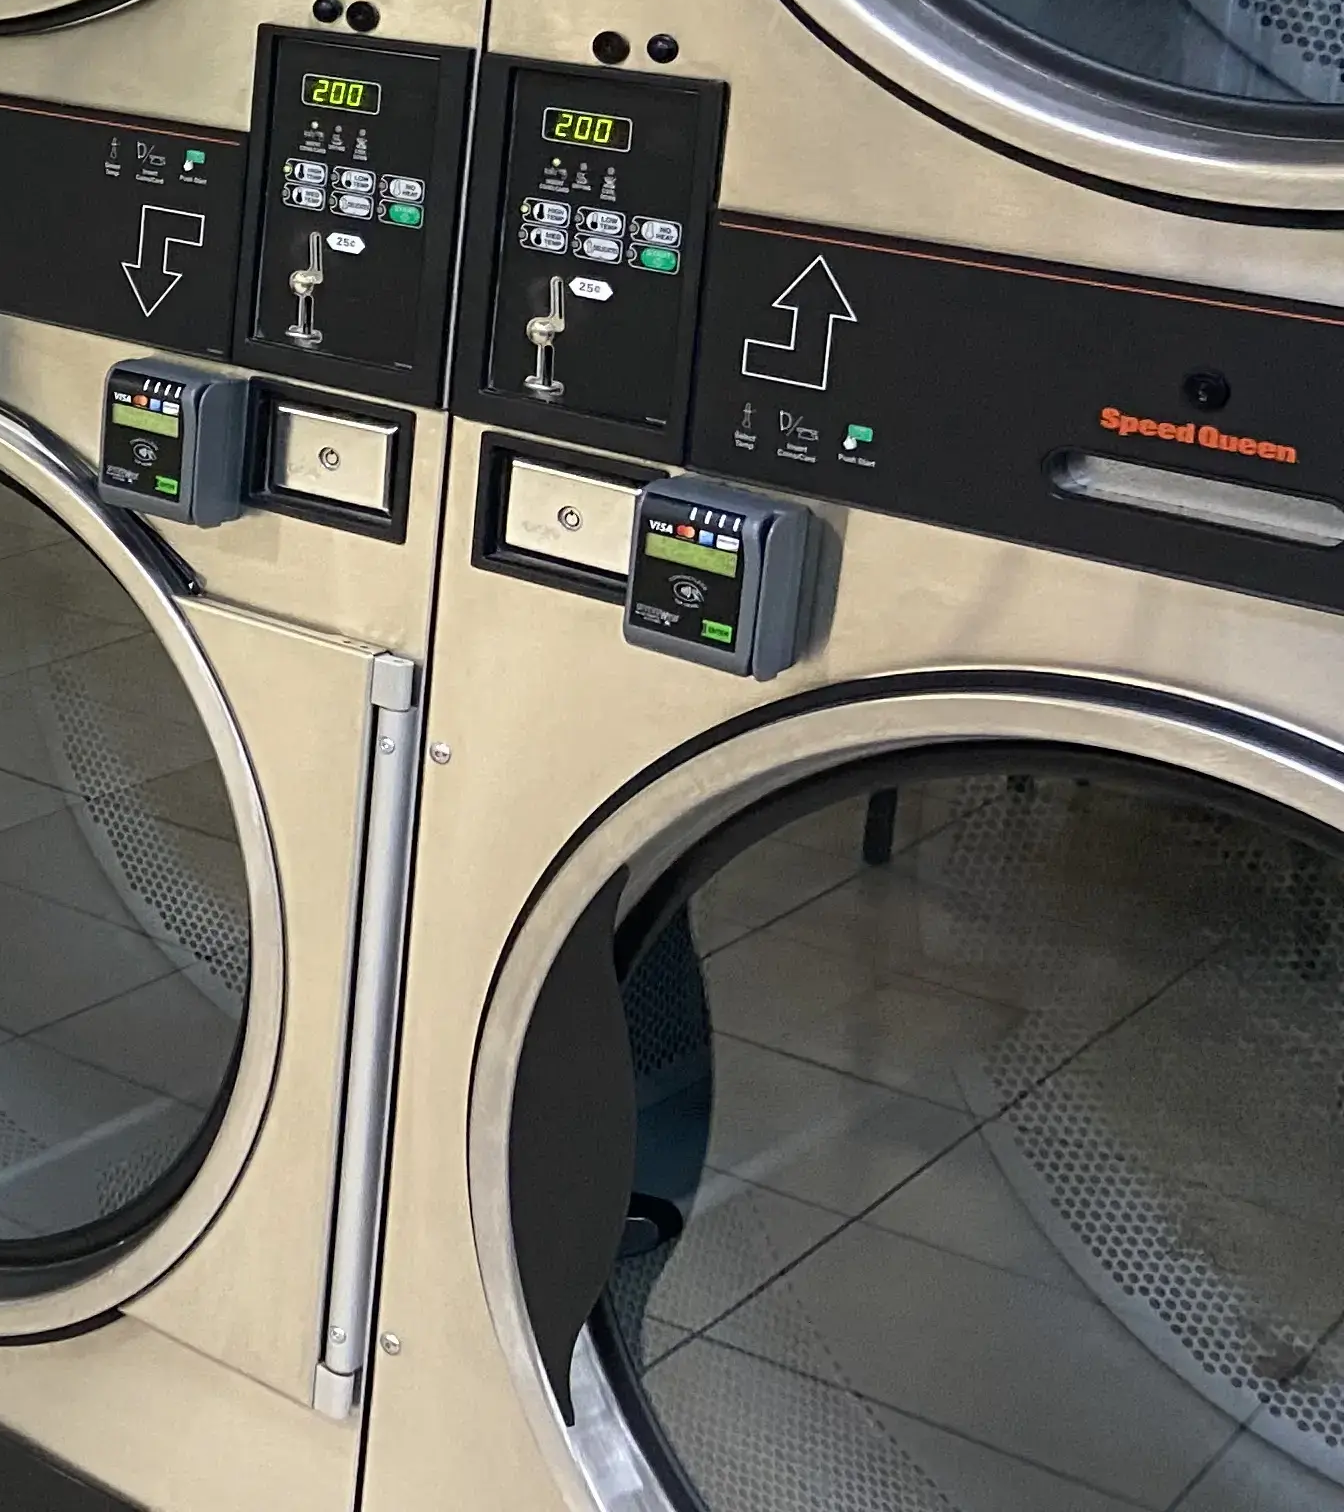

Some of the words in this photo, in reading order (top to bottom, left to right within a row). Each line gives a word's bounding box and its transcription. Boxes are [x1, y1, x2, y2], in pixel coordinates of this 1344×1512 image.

[312, 79, 363, 107] 200
[554, 113, 613, 144] 200
[600, 216, 618, 224] LOW
[336, 236, 356, 248] 25¢
[578, 281, 601, 294] 25¢
[113, 391, 132, 404] VISA
[1099, 406, 1196, 444] Speed
[1197, 425, 1298, 464] Queen
[649, 519, 674, 535] VISA
